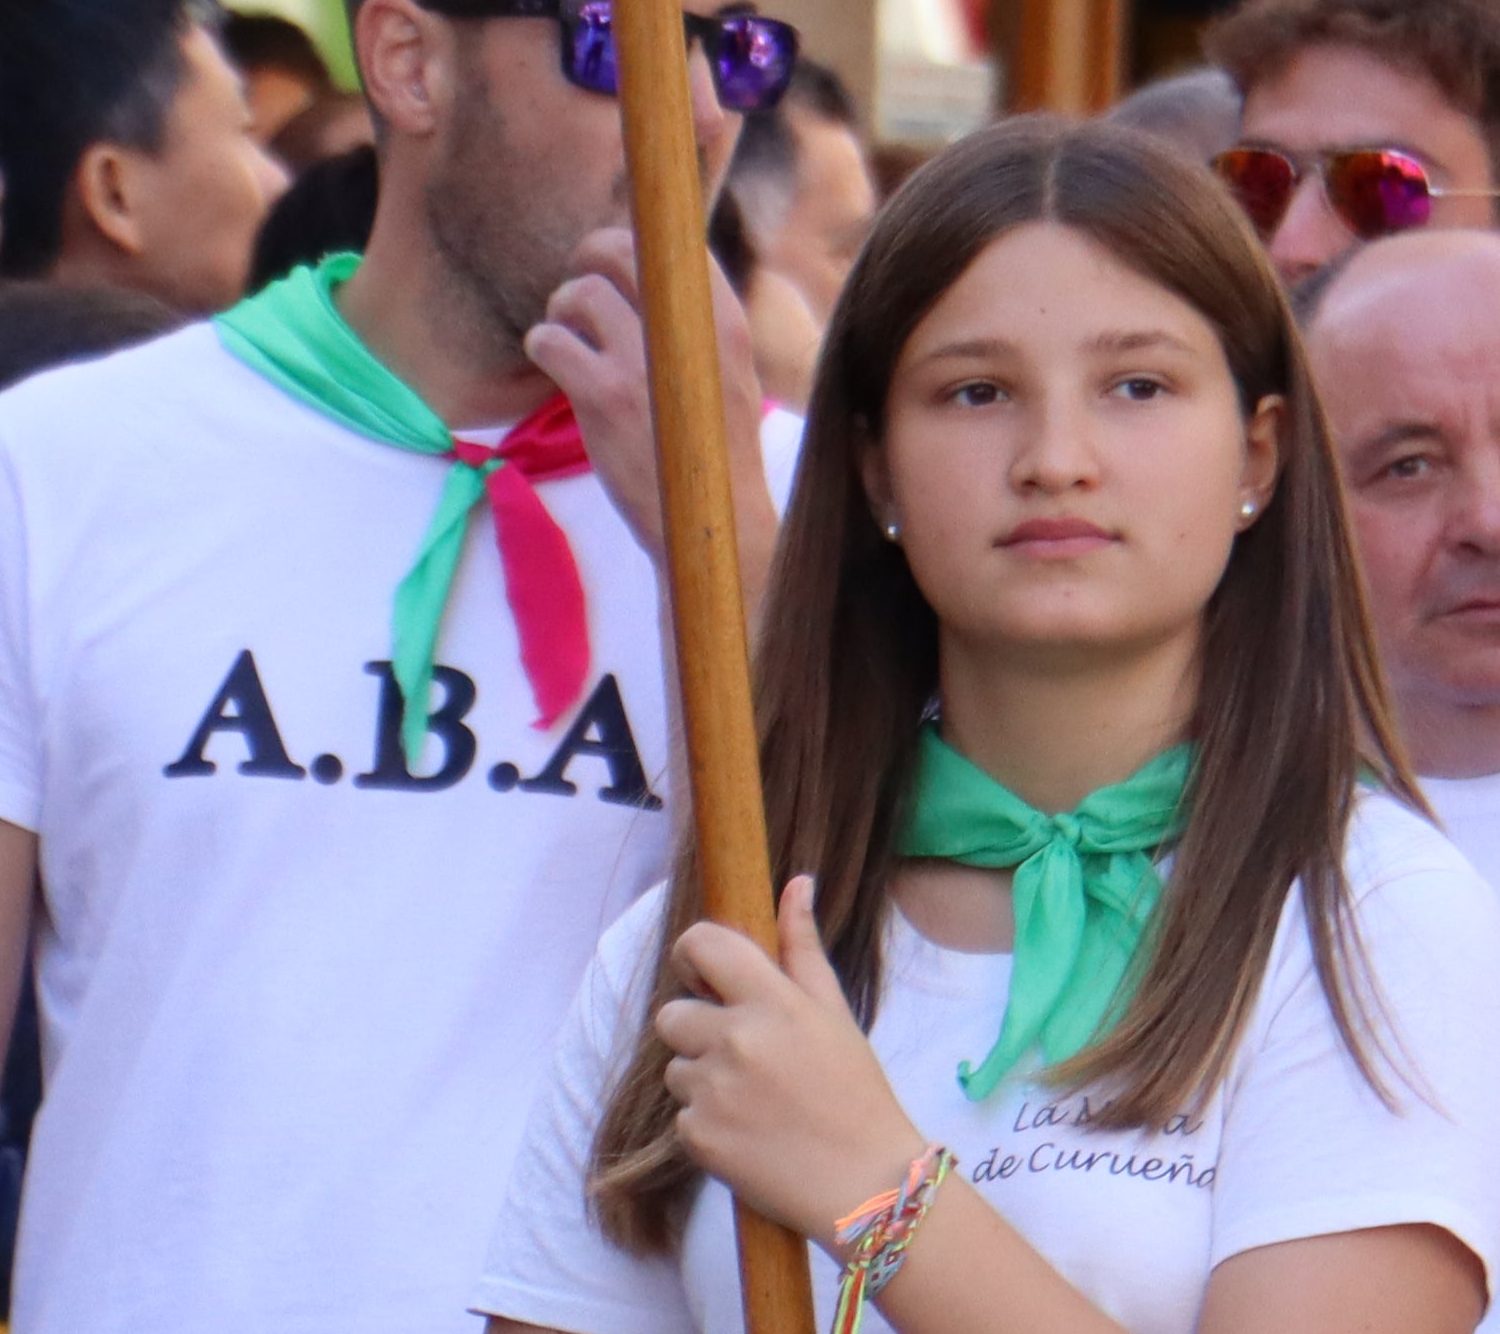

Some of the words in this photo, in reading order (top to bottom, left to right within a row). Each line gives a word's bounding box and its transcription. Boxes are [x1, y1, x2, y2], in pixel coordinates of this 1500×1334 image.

[1013, 1102, 1068, 1134] La
[972, 1147, 1025, 1184] de
[1027, 1142, 1218, 1190] Curueño
